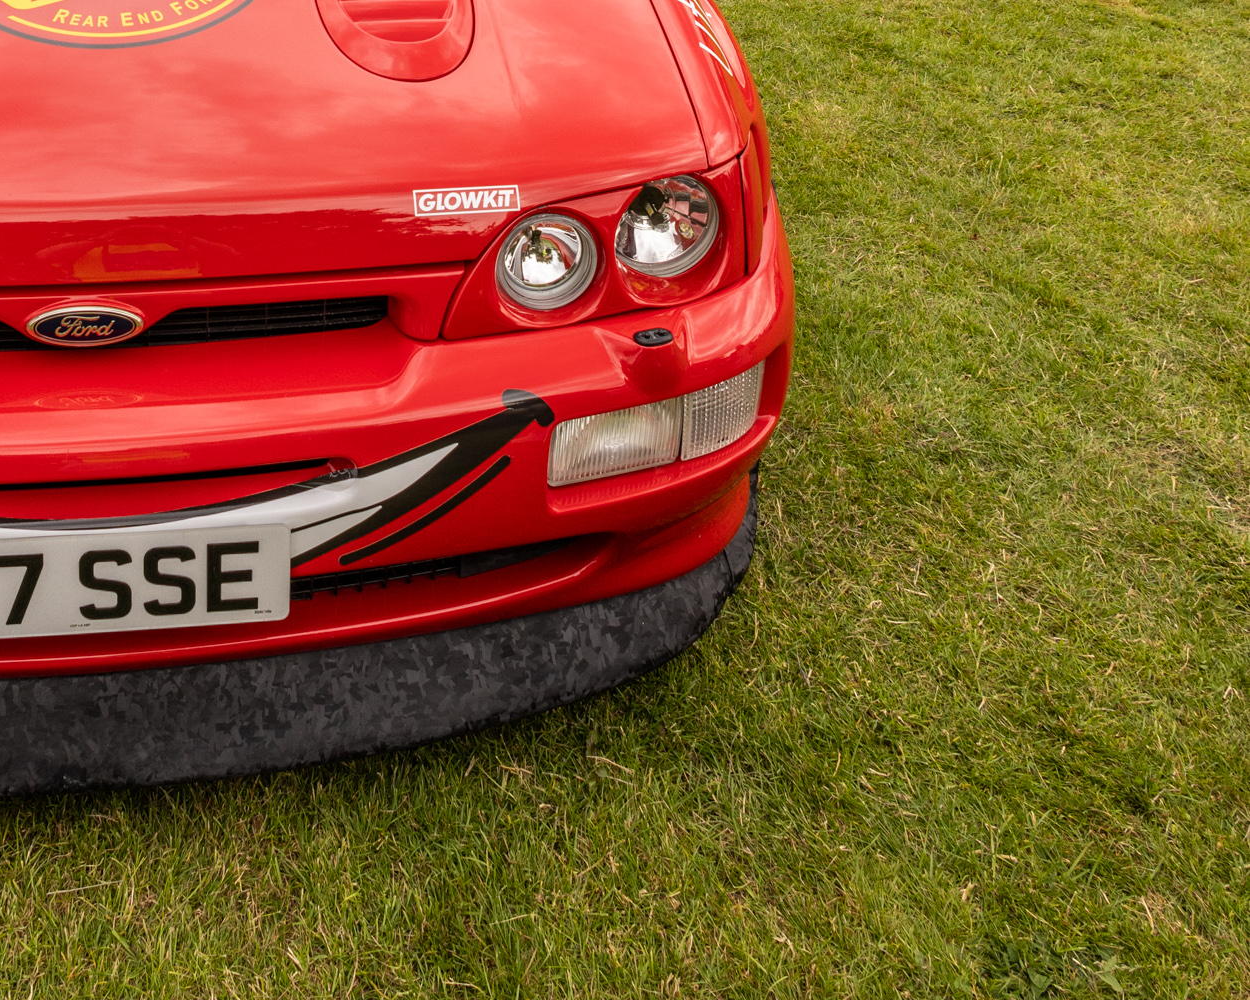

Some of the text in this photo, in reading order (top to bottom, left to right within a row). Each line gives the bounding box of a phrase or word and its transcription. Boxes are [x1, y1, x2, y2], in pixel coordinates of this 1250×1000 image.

[52, 8, 109, 28] REAR
[120, 9, 164, 27] END
[54, 315, 117, 338] Ford
[78, 540, 260, 621] SSE
